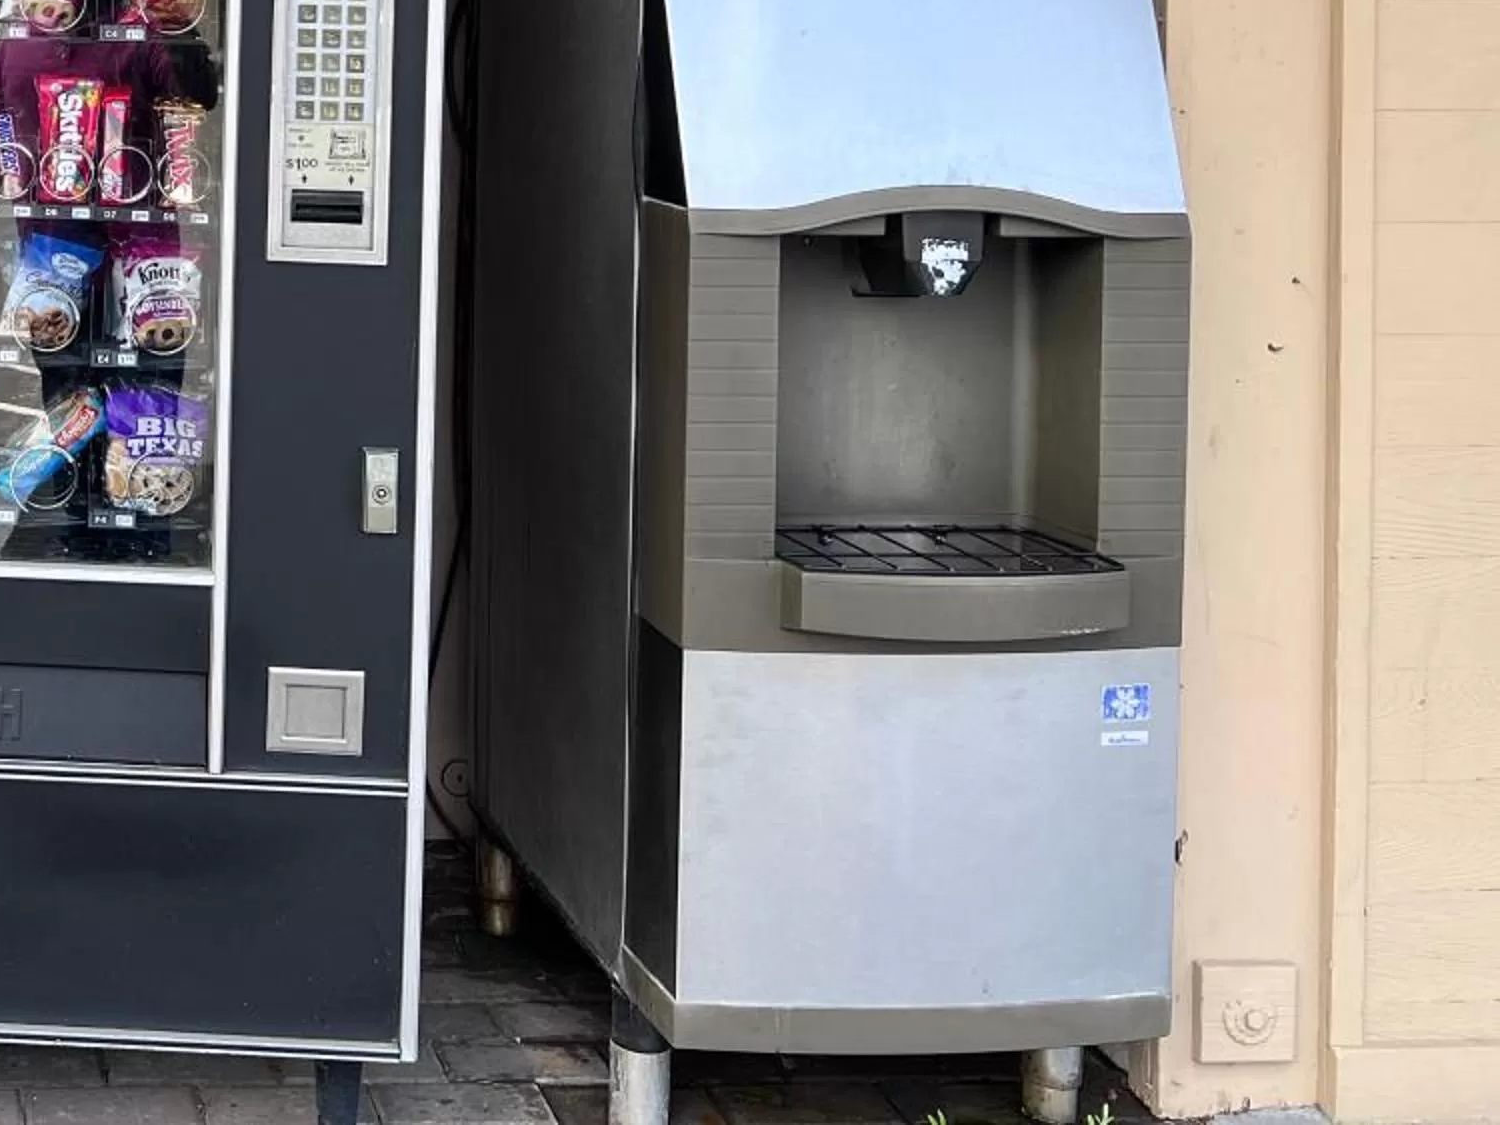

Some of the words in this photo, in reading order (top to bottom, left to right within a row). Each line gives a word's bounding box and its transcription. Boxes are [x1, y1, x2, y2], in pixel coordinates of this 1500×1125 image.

[105, 30, 118, 39] C4
[55, 92, 84, 193] Skittles
[104, 210, 117, 219] D7
[98, 355, 109, 364] E4
[136, 417, 197, 438] BIG
[127, 438, 204, 458] TEXAS
